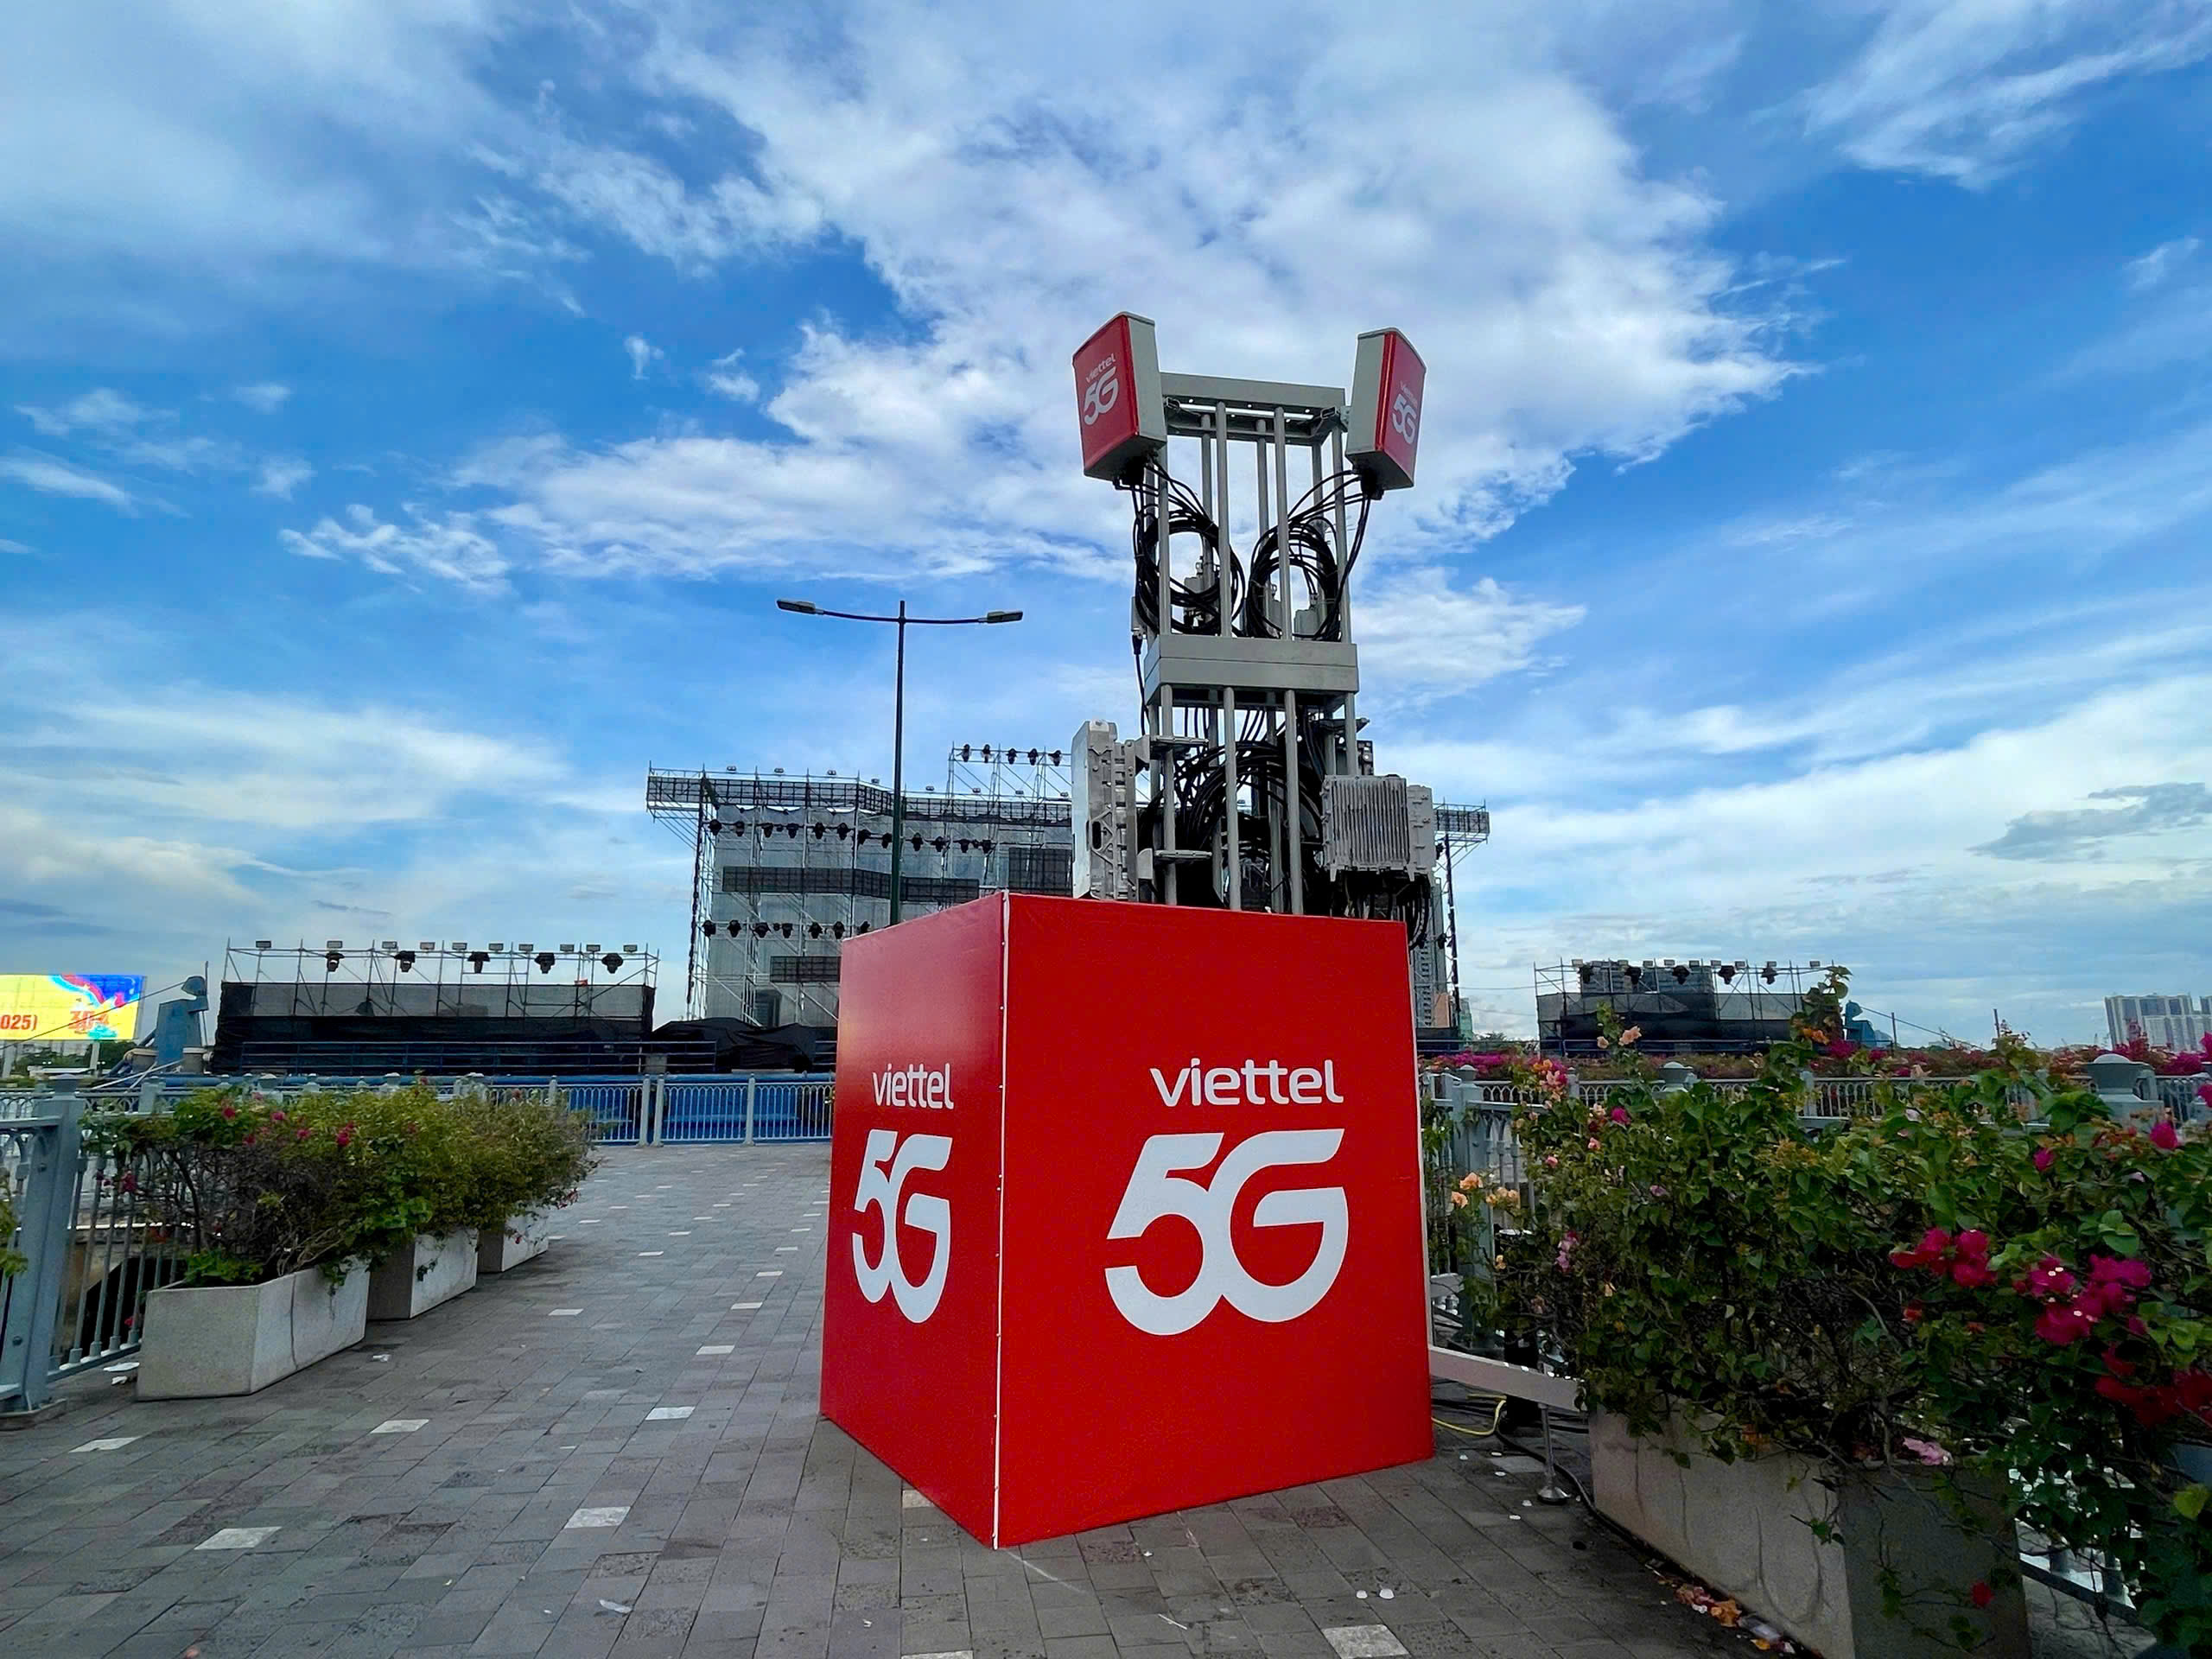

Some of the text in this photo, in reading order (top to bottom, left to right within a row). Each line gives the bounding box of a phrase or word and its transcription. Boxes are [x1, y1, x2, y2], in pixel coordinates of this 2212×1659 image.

[1084, 366, 1119, 425] 5G
[1392, 393, 1417, 444] 5G
[873, 1063, 955, 1109] viettel
[1149, 1058, 1344, 1107] viettel
[852, 1128, 953, 1324] 5G
[1104, 1128, 1349, 1336] 5G
